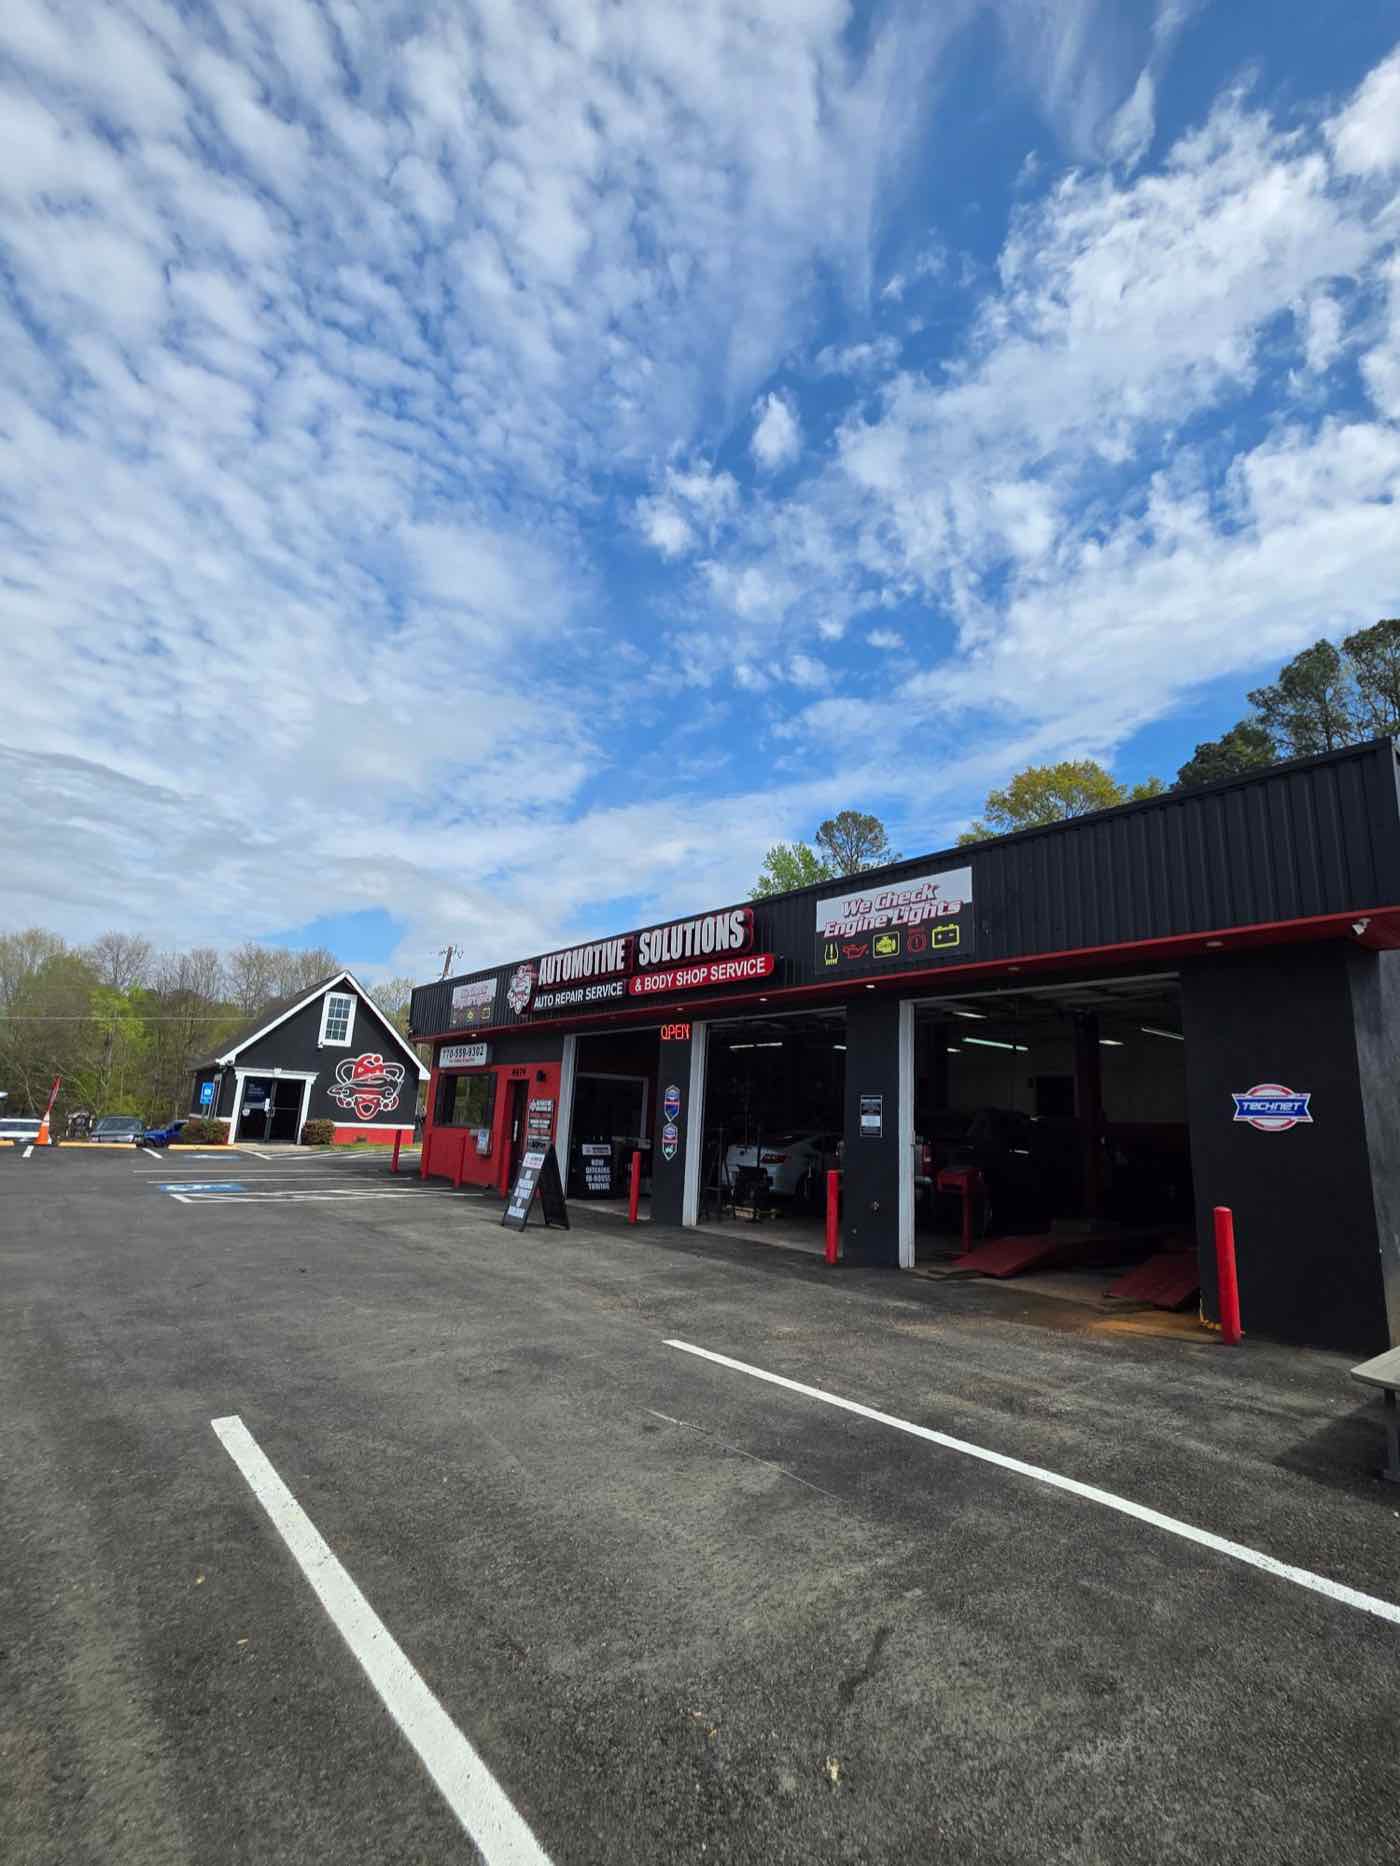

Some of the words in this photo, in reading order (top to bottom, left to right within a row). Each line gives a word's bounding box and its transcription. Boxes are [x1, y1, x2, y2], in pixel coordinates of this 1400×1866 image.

[842, 897, 870, 918] We
[875, 883, 939, 911] Check
[824, 914, 887, 938] Engine
[891, 901, 961, 926] Lights
[538, 938, 625, 985] AUTOMOTIVE
[639, 910, 745, 966] SOLUTIONS
[634, 978, 642, 993] &
[644, 973, 674, 991] BODY
[676, 967, 708, 986] SHOP
[710, 957, 766, 980] SERVICE
[534, 994, 554, 1008] AUTO
[555, 988, 584, 1005] REPAIR
[585, 982, 623, 1000] SERVICE
[661, 1024, 690, 1040] OPEN
